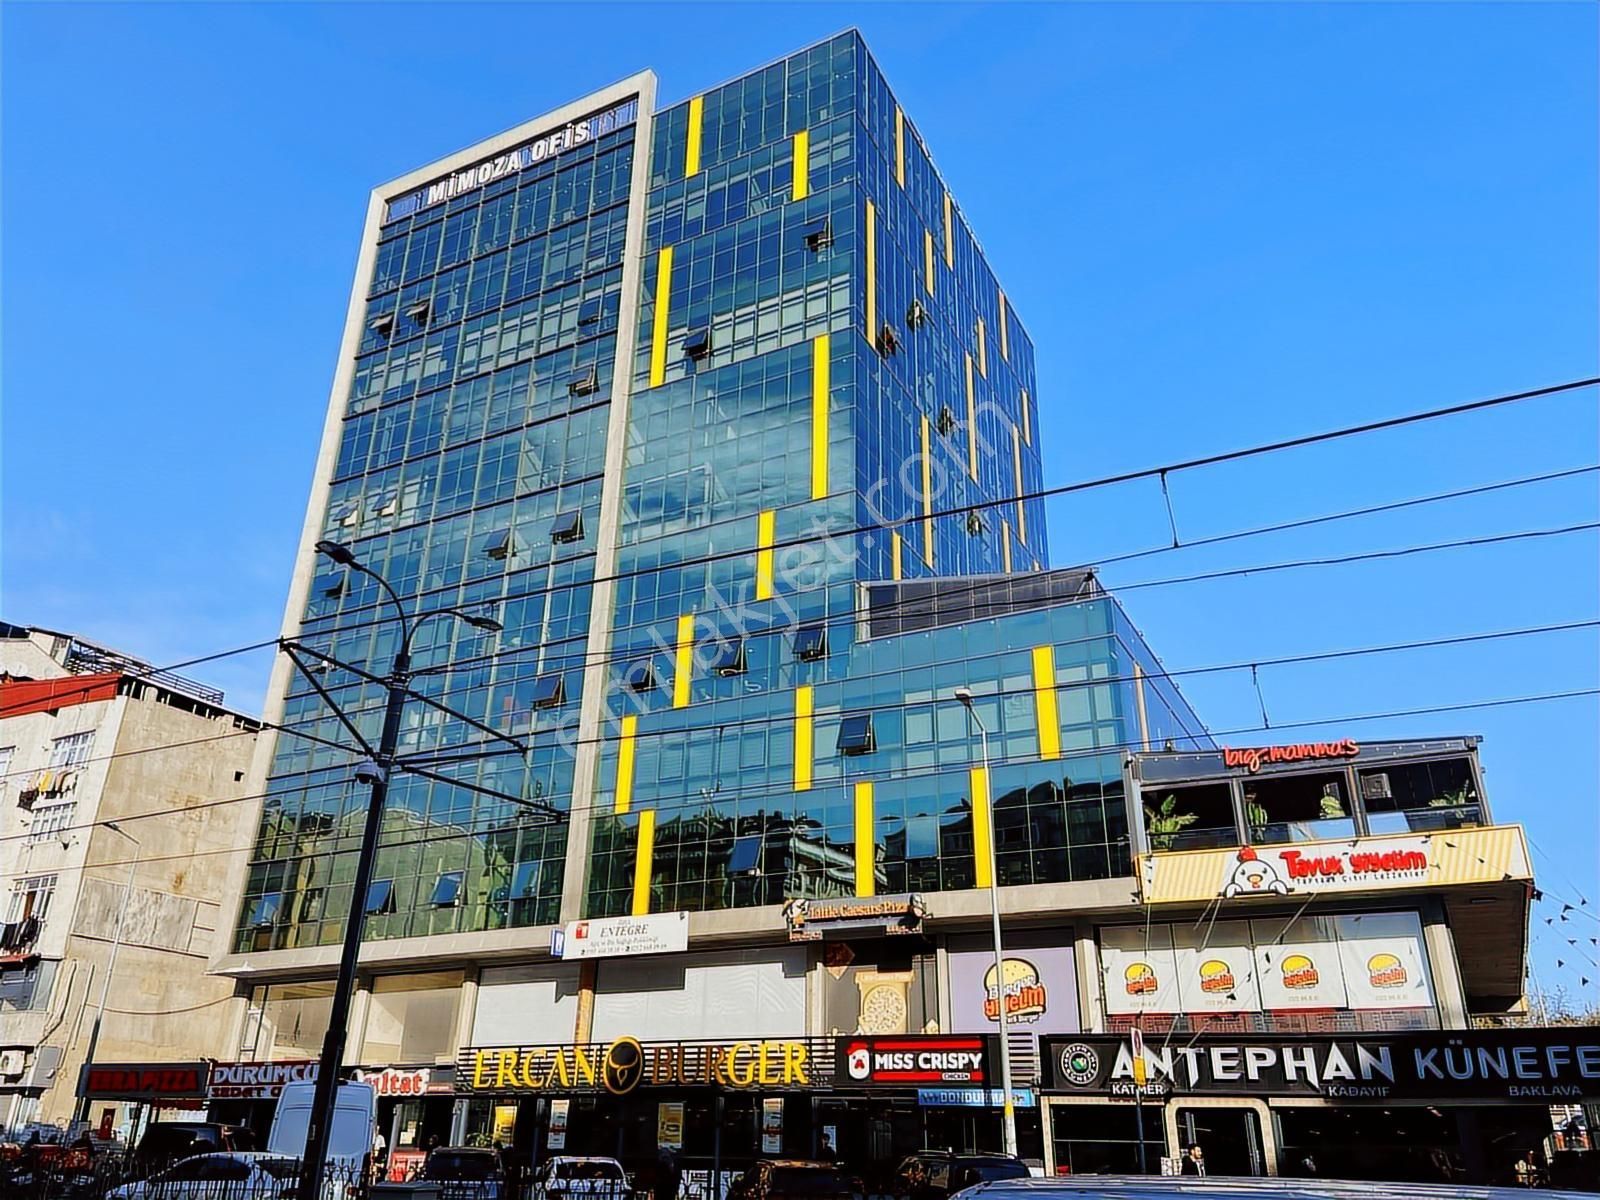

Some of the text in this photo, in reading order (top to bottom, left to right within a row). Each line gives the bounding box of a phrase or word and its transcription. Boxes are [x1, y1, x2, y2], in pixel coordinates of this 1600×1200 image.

[532, 122, 590, 162] OFİS
[1224, 739, 1360, 772] big mamma's
[1279, 850, 1344, 879] Tavuk
[840, 902, 883, 916] Caesars
[214, 1061, 319, 1084] DÜRÜMCÜ
[473, 1041, 811, 1089] ERCAN BURGER
[875, 1052, 983, 1070] MISS CRISPY
[1111, 1039, 1395, 1092] ANTEPHAN
[1508, 1085, 1583, 1097] BAKLAVA
